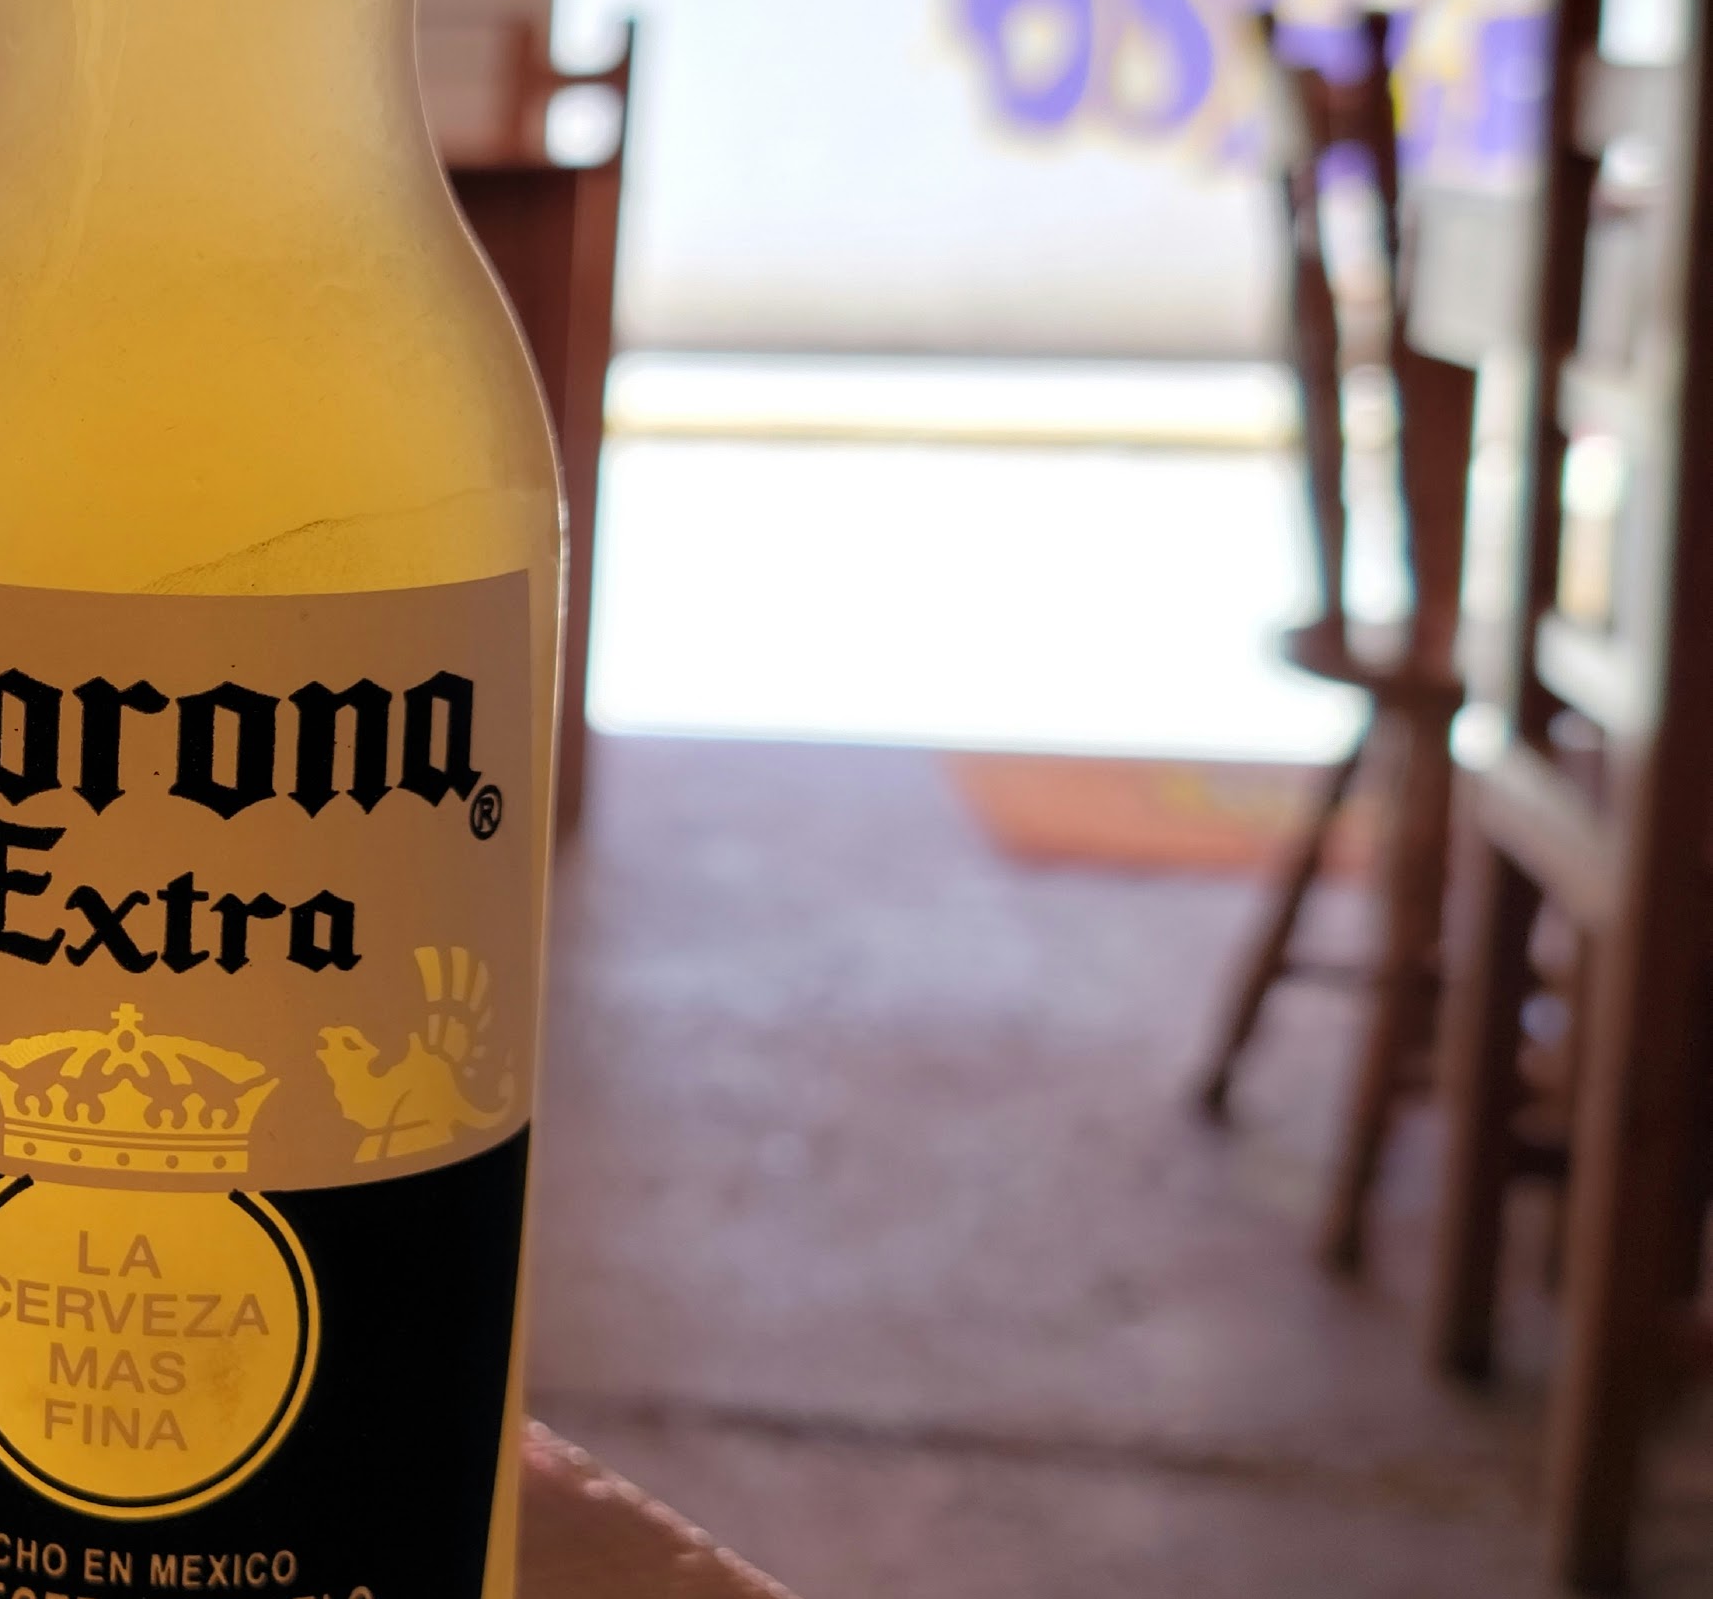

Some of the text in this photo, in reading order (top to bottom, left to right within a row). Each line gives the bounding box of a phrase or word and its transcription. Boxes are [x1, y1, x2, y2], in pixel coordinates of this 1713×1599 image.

[77, 1229, 163, 1280] LA
[48, 1341, 187, 1396] MAS
[43, 1397, 189, 1451] FINA
[83, 1547, 134, 1587] EN
[149, 1549, 299, 1589] MEXICO
